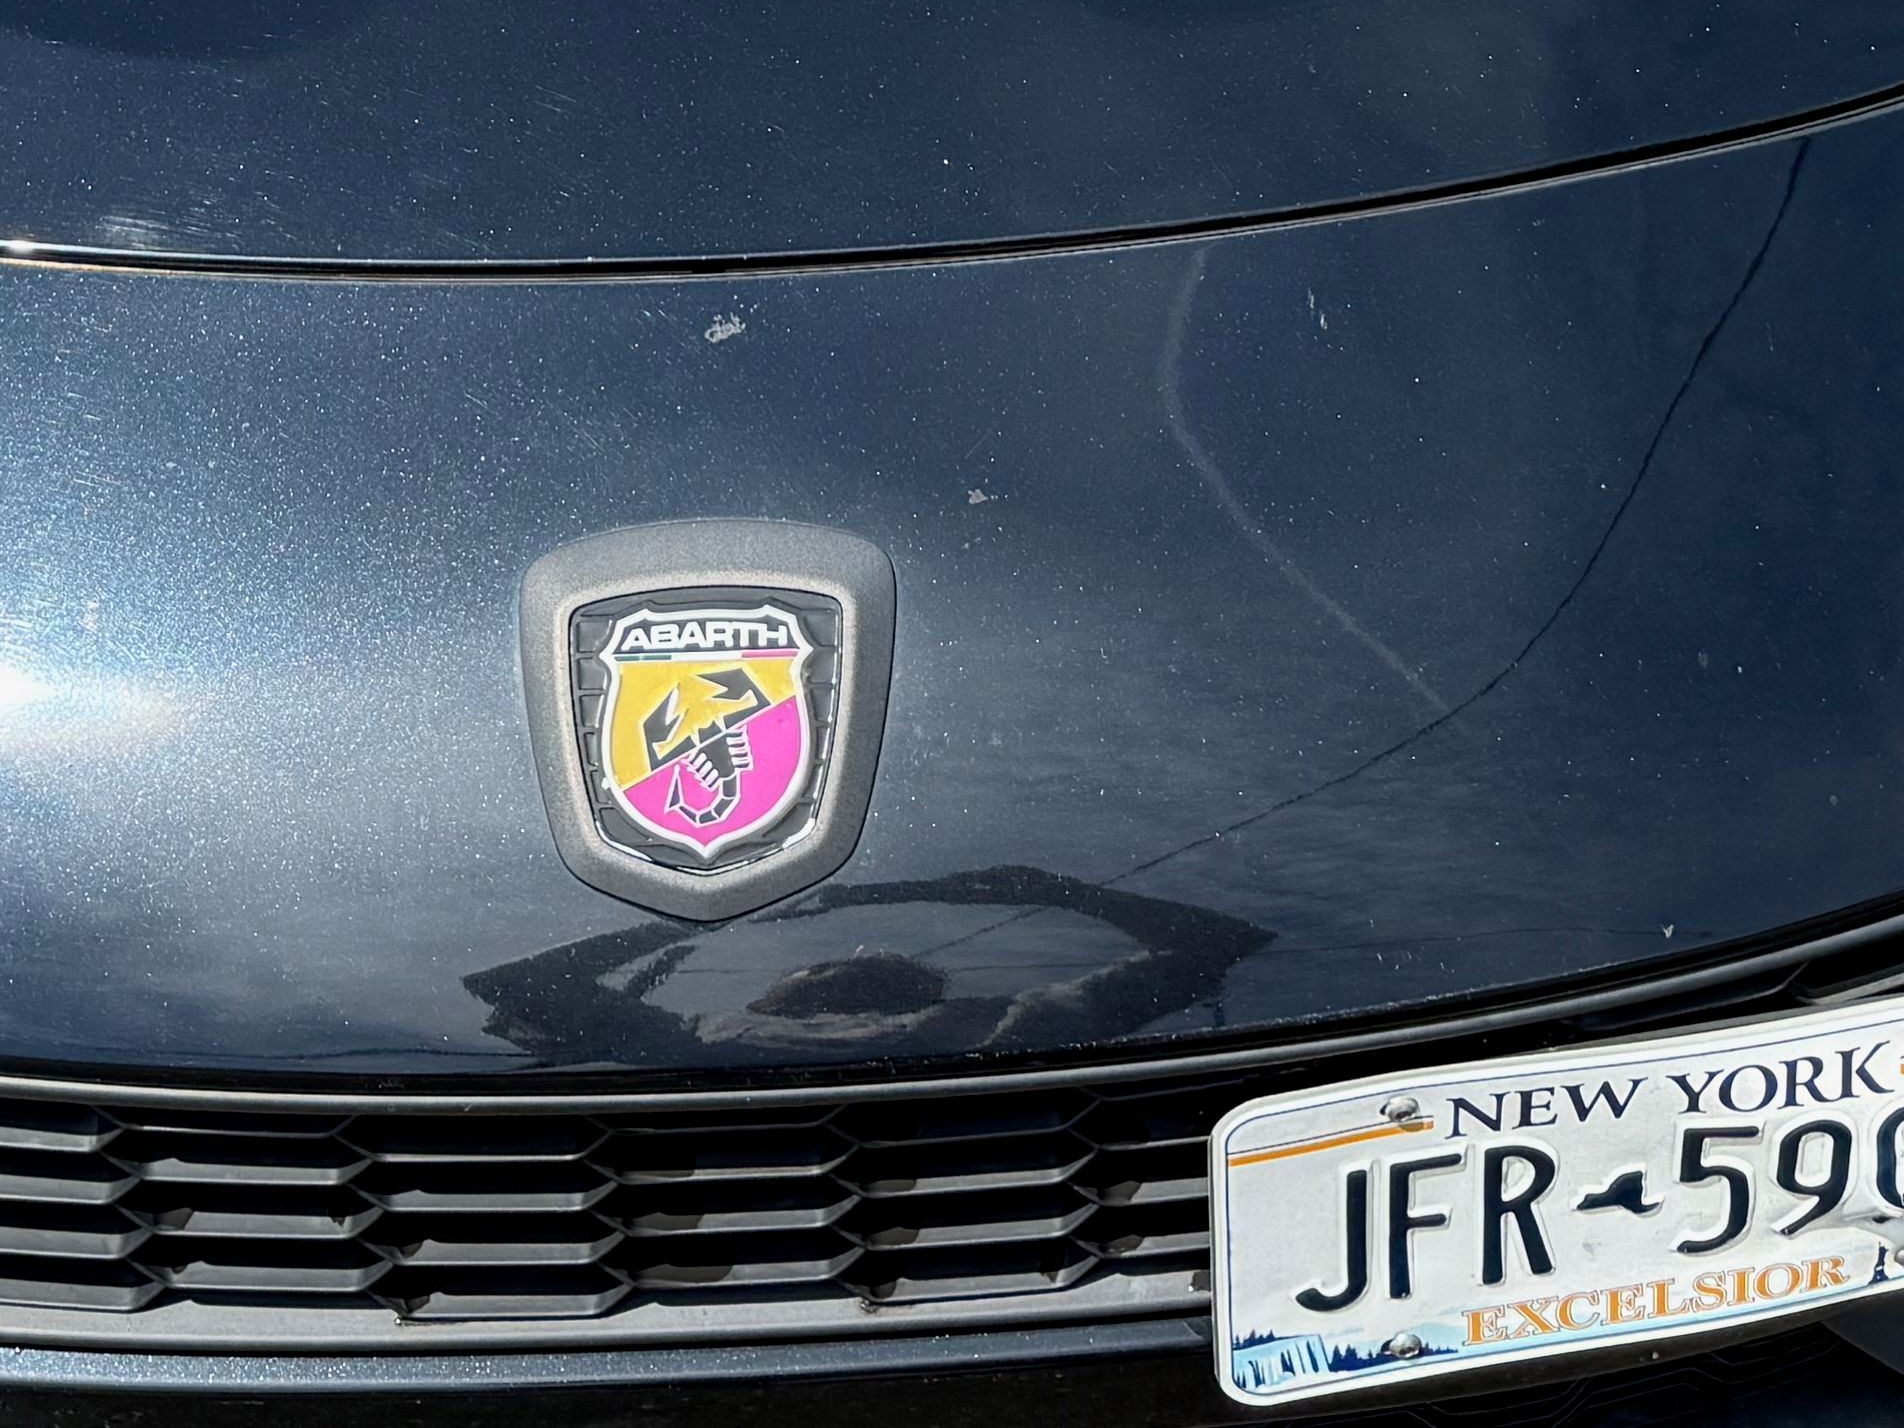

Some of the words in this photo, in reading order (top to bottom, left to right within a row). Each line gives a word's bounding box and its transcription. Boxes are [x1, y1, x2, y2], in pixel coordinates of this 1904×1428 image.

[621, 622, 788, 651] ABARTH
[1445, 1076, 1649, 1140] NEW
[1666, 1040, 1895, 1115] YORK
[1295, 1144, 1556, 1312] JFR
[1462, 1255, 1850, 1346] EXCELSIOR
